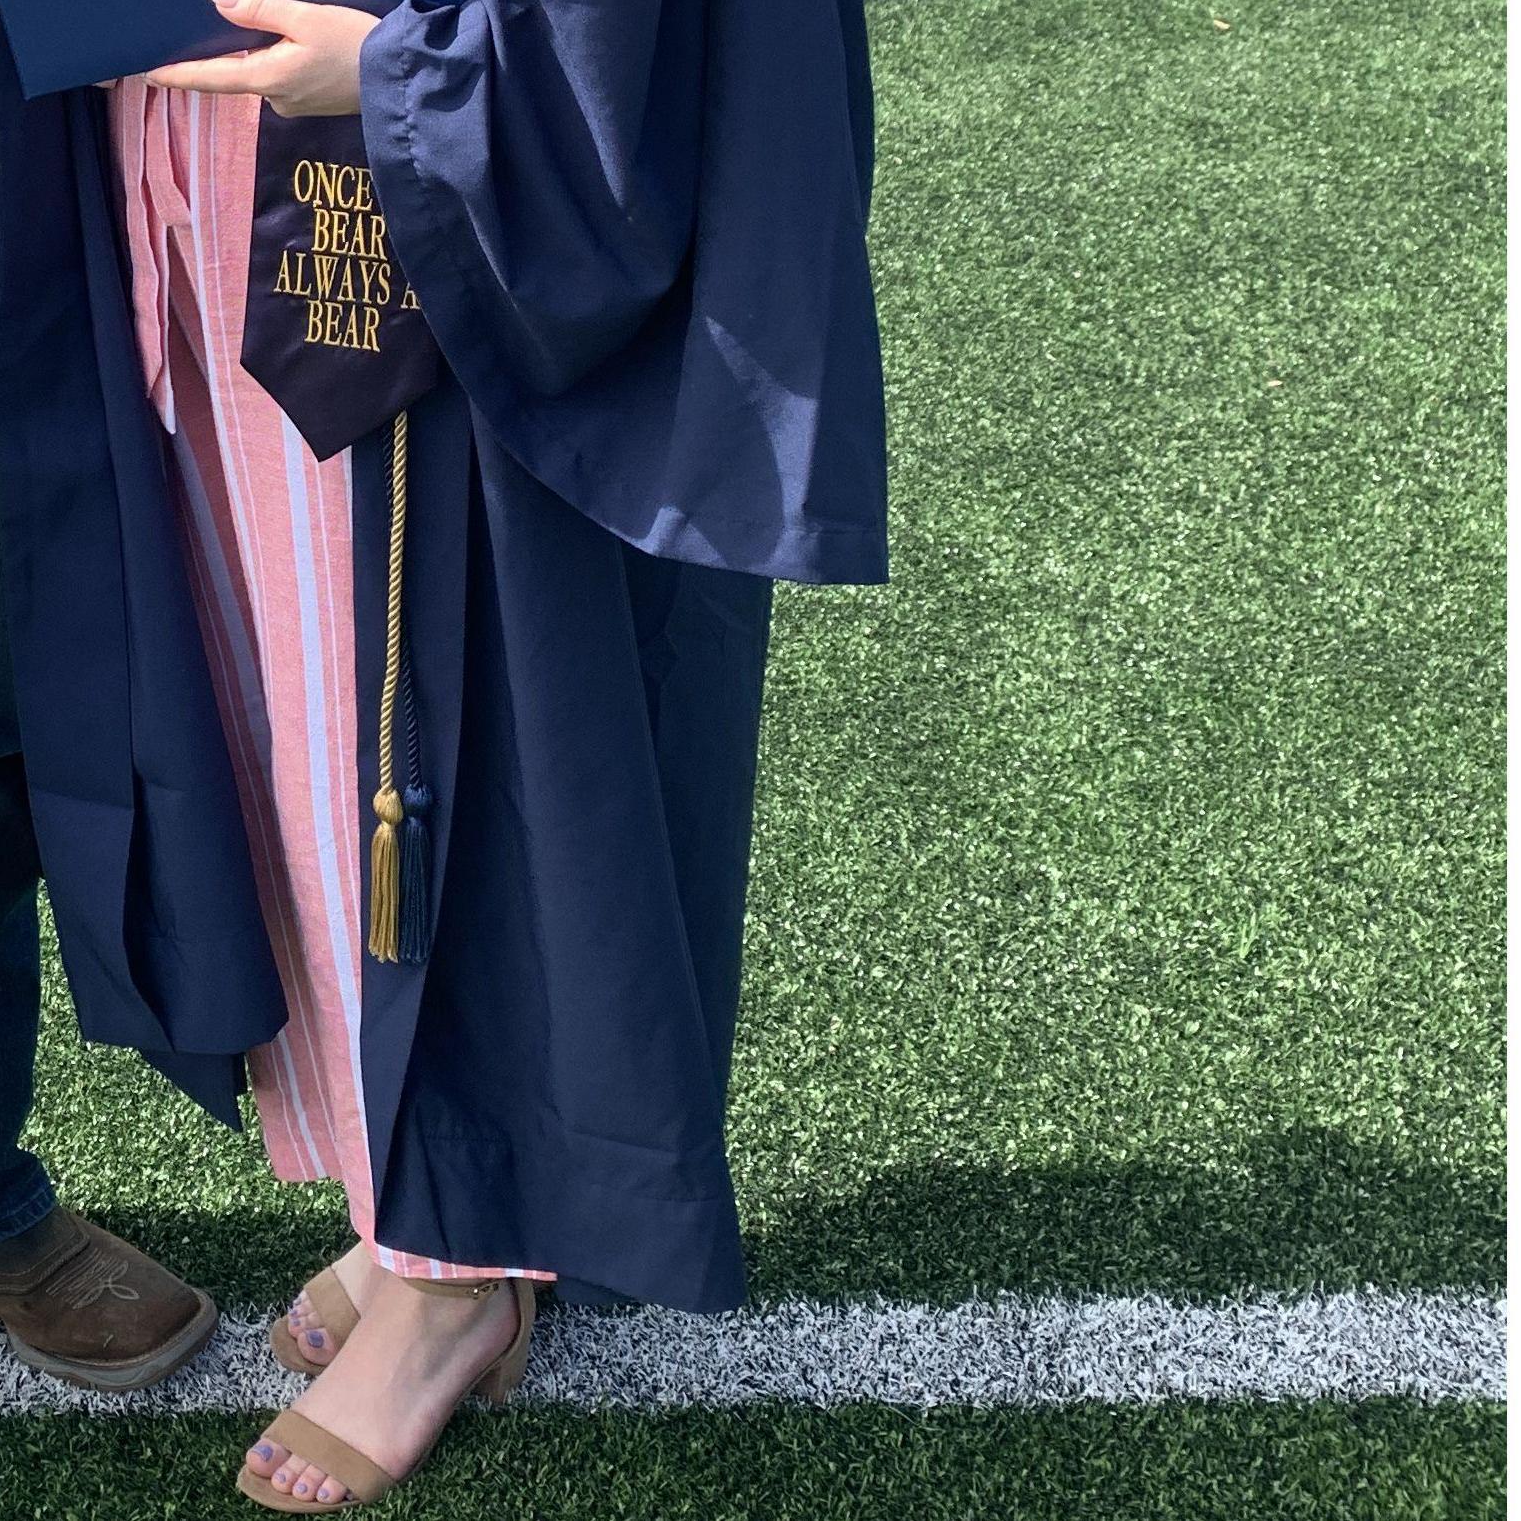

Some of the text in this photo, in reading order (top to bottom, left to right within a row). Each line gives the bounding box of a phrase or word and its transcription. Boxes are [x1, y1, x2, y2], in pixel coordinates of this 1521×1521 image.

[293, 159, 373, 213] ONCE
[311, 208, 387, 263] BEAR
[273, 249, 392, 307] ALWAYS
[304, 301, 381, 353] BEAR
